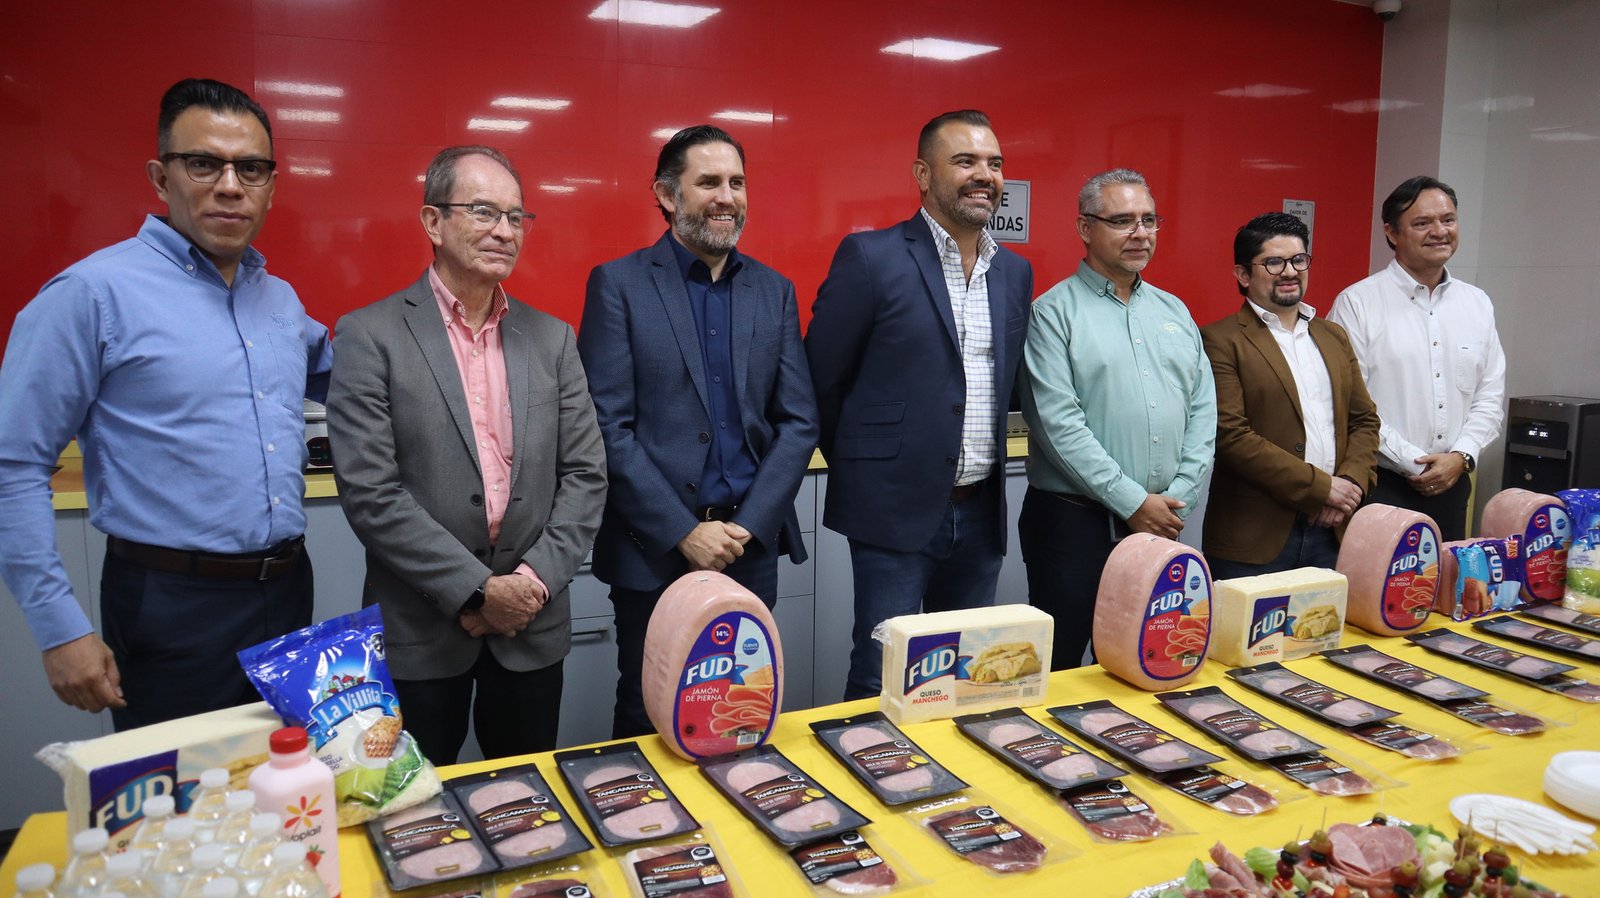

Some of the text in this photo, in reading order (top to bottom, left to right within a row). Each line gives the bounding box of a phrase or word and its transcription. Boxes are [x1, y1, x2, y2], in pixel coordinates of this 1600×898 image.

[1526, 534, 1554, 558] FUD
[1391, 554, 1418, 575] FUD
[1484, 546, 1503, 582] FUD
[1150, 592, 1184, 616] FUD
[1252, 609, 1286, 642] FUD
[686, 657, 733, 685] FUD
[908, 649, 956, 688] FUD
[692, 685, 720, 694] JAMÓN
[912, 695, 949, 704] MANCHEGO
[920, 689, 942, 697] QUESO
[318, 687, 381, 726] La Villita
[595, 783, 653, 798] TANGAMANGA
[484, 806, 548, 823] TANGAMANGA
